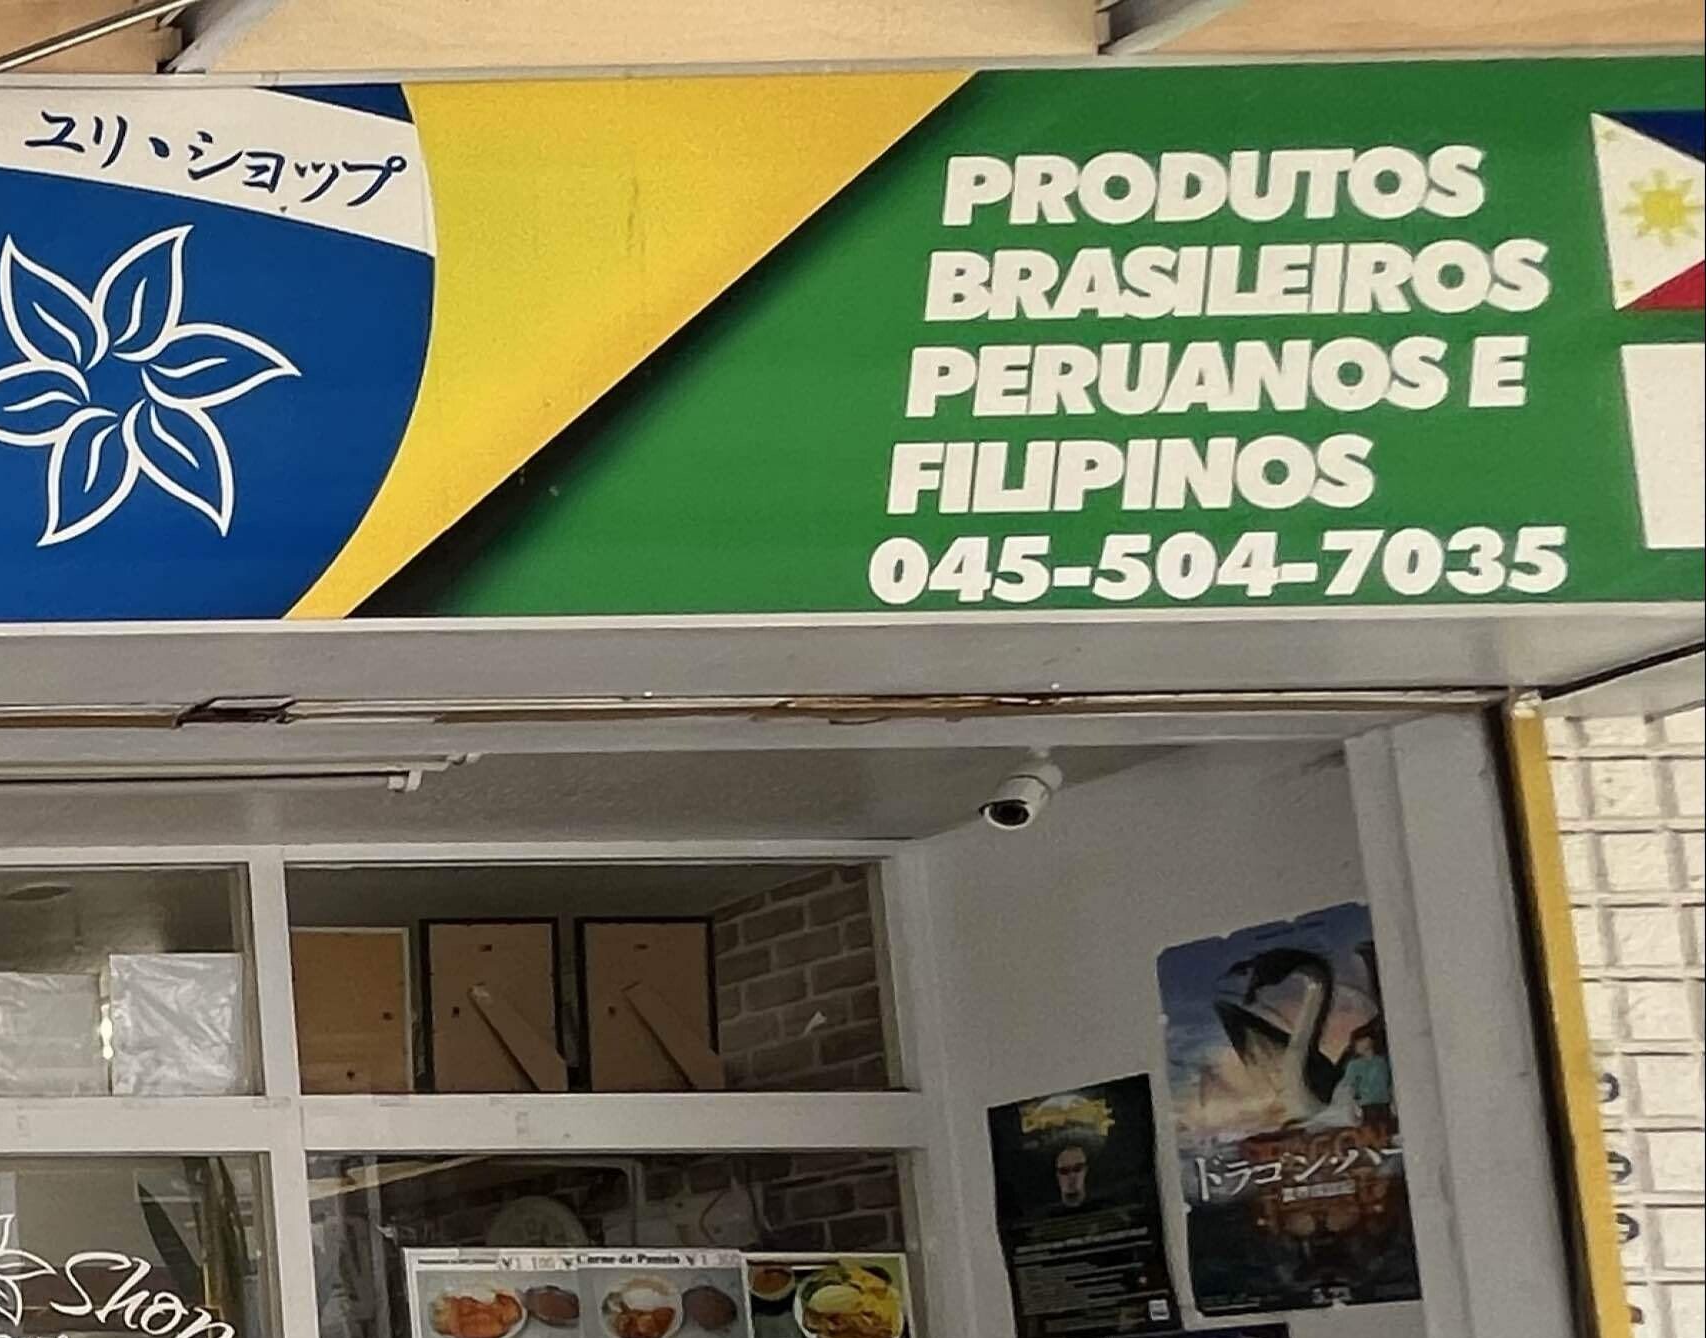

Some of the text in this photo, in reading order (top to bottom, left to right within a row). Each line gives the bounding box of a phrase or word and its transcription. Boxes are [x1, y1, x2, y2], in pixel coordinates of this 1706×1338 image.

[25, 110, 408, 208] ユリ・ショップ
[942, 145, 1486, 227] PRODUTOS
[923, 238, 1550, 322] BRASILEIROS
[904, 335, 1530, 418] PERUANOS E
[886, 433, 1376, 515] FILIPINOS
[868, 525, 1569, 605] 045-504-7035
